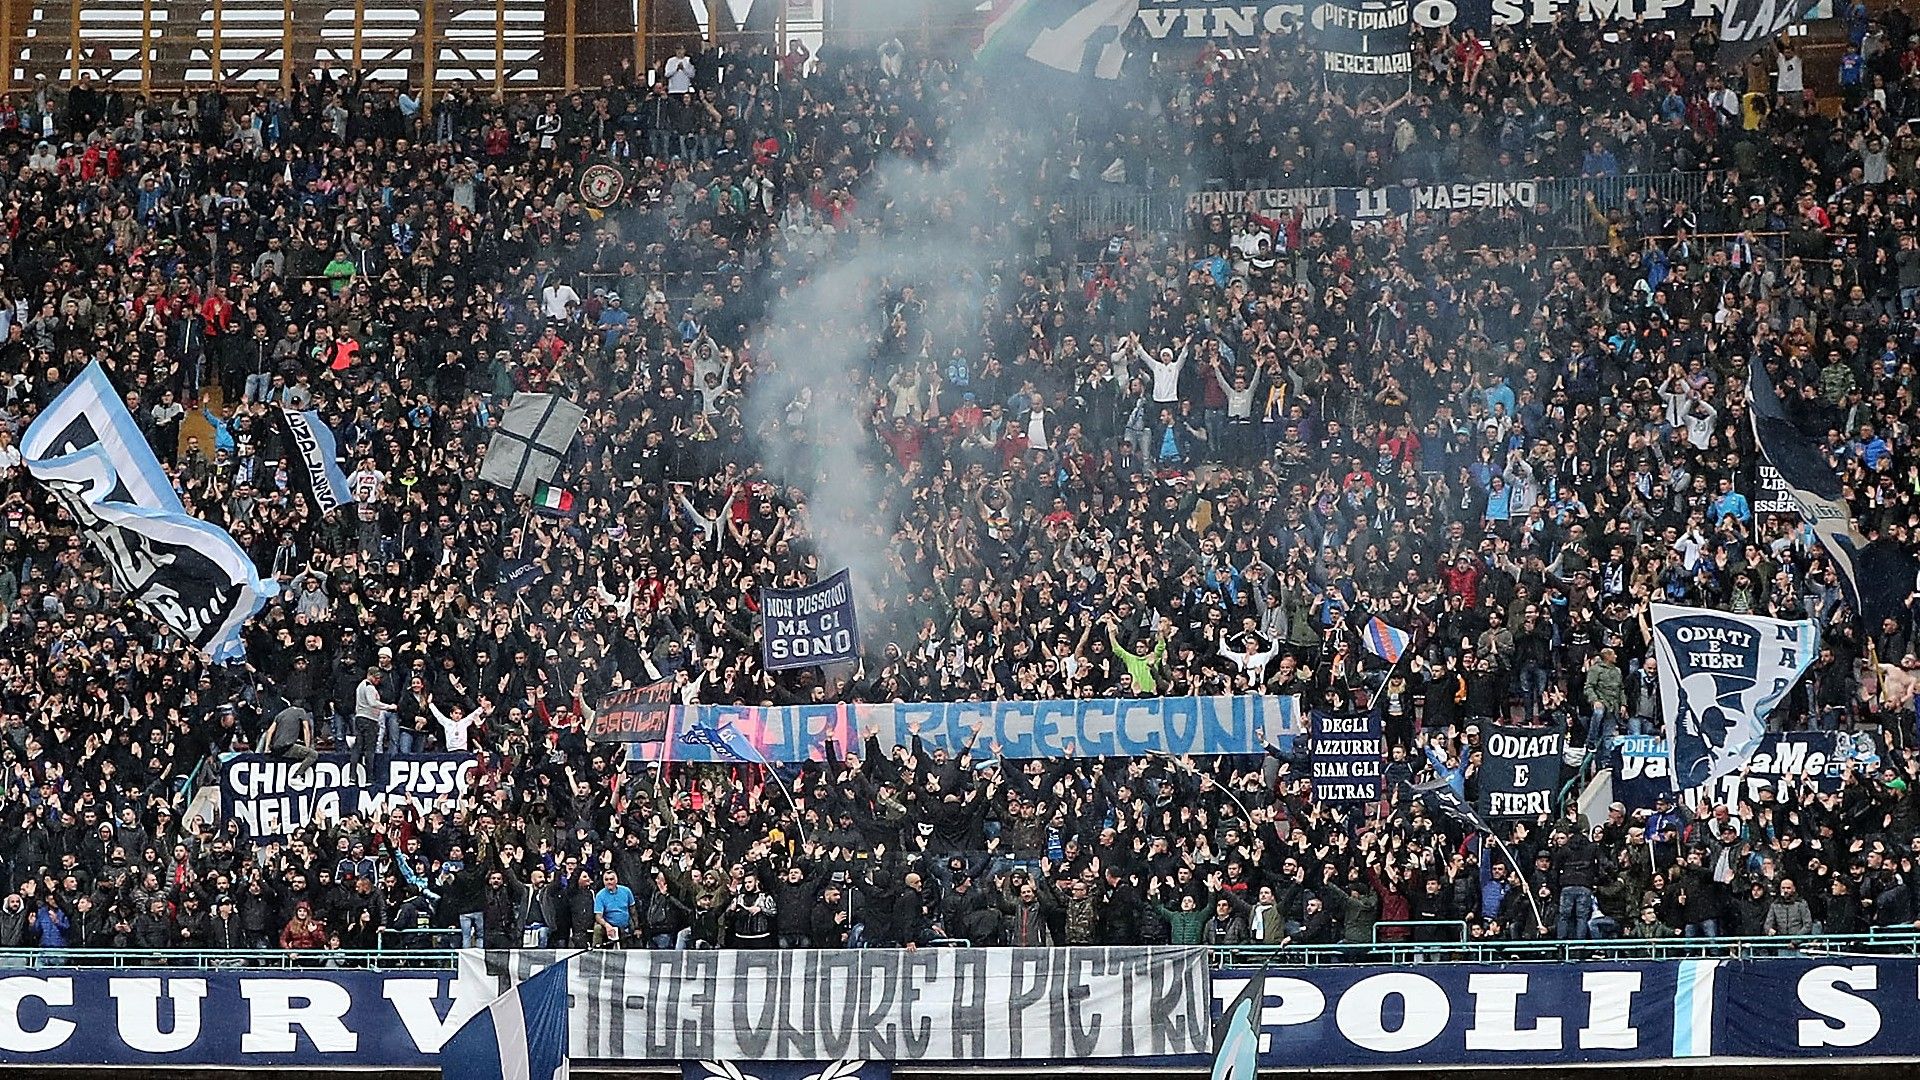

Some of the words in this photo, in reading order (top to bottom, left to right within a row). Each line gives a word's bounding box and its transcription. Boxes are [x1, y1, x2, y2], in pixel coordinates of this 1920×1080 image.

[1139, 0, 1457, 38] VINCO
[1325, 51, 1412, 74] MERCENARI!
[1356, 188, 1390, 217] 11
[1415, 181, 1536, 209] MASSIMO
[1761, 478, 1789, 490] LIB
[1755, 500, 1800, 513] ESSER
[767, 598, 793, 618] NON
[797, 581, 847, 616] POSSONO
[777, 620, 810, 635] MA
[820, 611, 840, 631] CI
[772, 630, 851, 659] SONO
[1677, 627, 1751, 648] ODIATI
[1709, 640, 1721, 652] E
[1689, 651, 1744, 669] FIERI
[1775, 625, 1798, 696] NAP
[1322, 717, 1369, 733] DEGLI
[1314, 739, 1380, 755] AZZURRI
[1488, 733, 1560, 759] ODIATI
[1313, 762, 1348, 777] SIAM
[1351, 761, 1380, 777] GLI
[1513, 764, 1530, 787] E
[1317, 784, 1375, 800] ULTRAS
[1489, 790, 1552, 815] FIERI
[1684, 774, 1819, 816] ULTRA
[234, 791, 340, 837] NELLA
[0, 976, 462, 1054] CURV
[1213, 970, 1644, 1054] POLI
[1797, 964, 1882, 1048] S
[952, 948, 989, 1058] A
